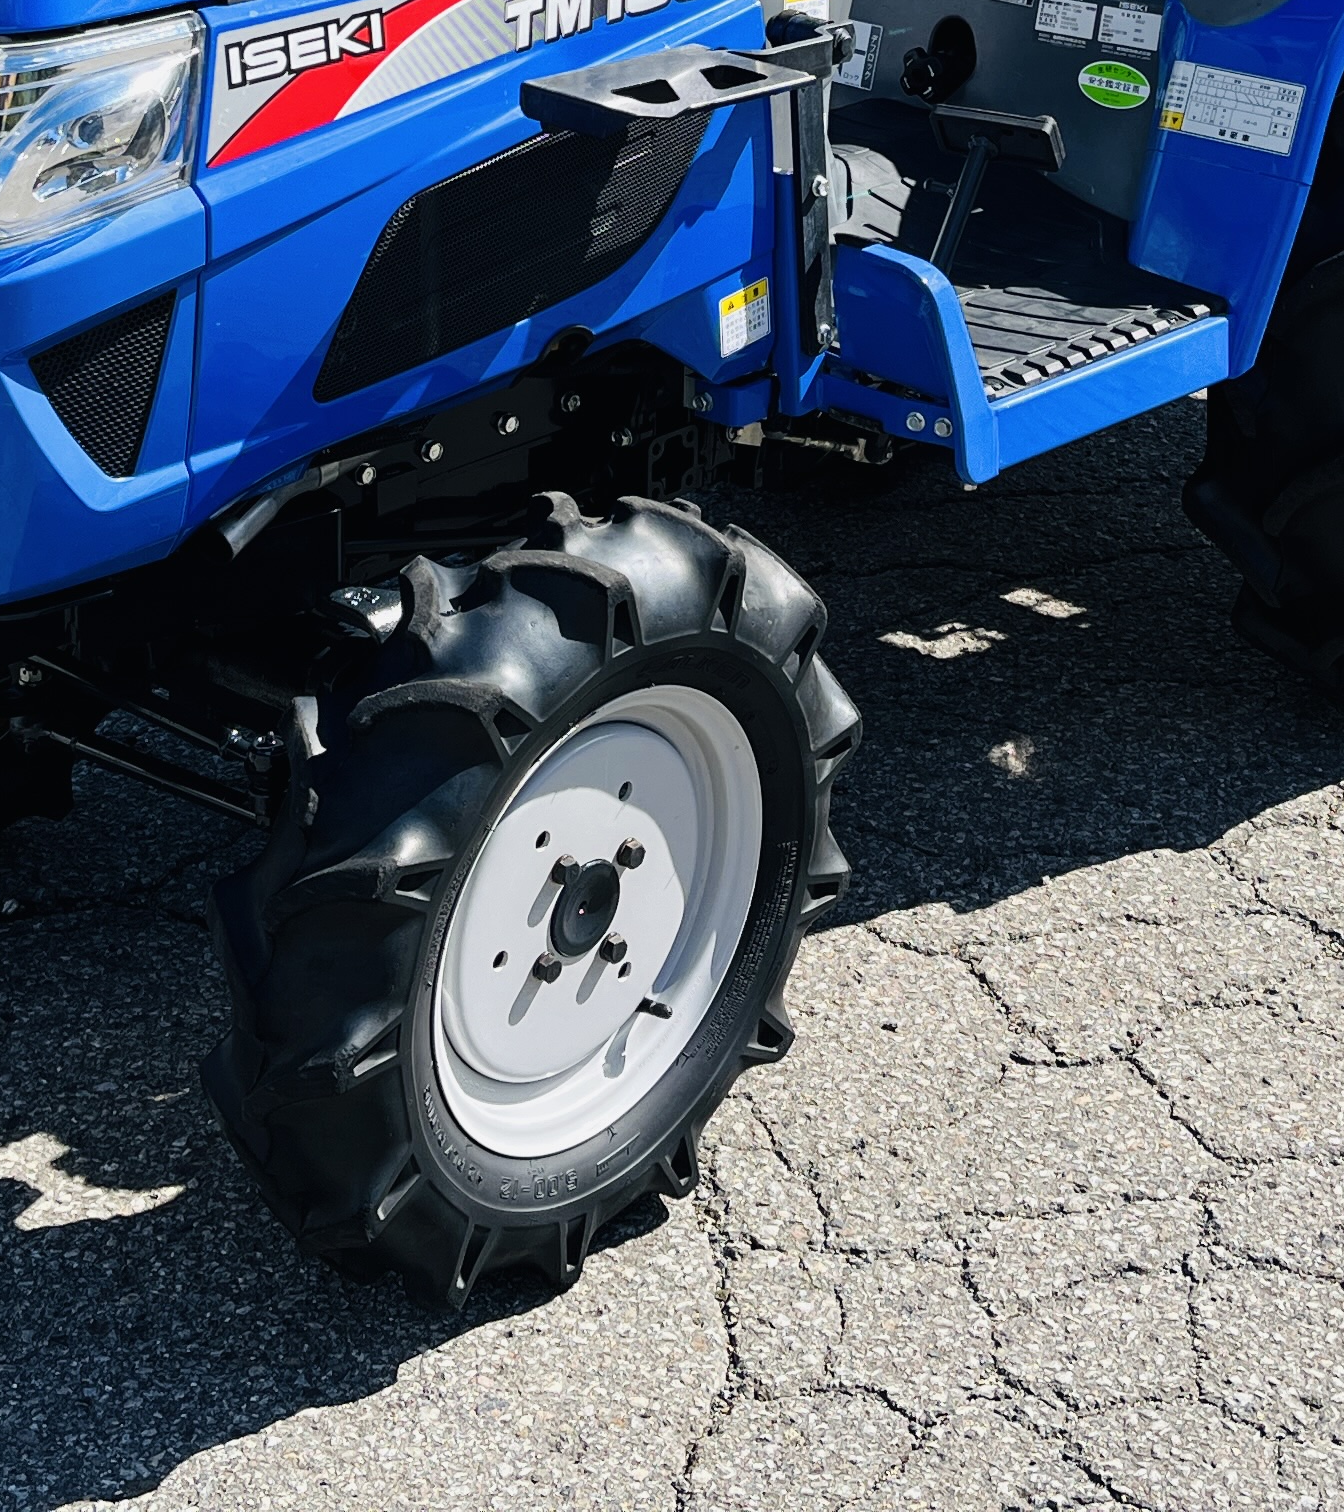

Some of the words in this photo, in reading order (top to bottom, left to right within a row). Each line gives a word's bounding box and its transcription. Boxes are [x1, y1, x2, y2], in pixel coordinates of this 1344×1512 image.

[1118, 1, 1149, 13] ISEKI
[226, 8, 386, 90] ISEKI
[499, 1168, 579, 1201] 5.00-12
